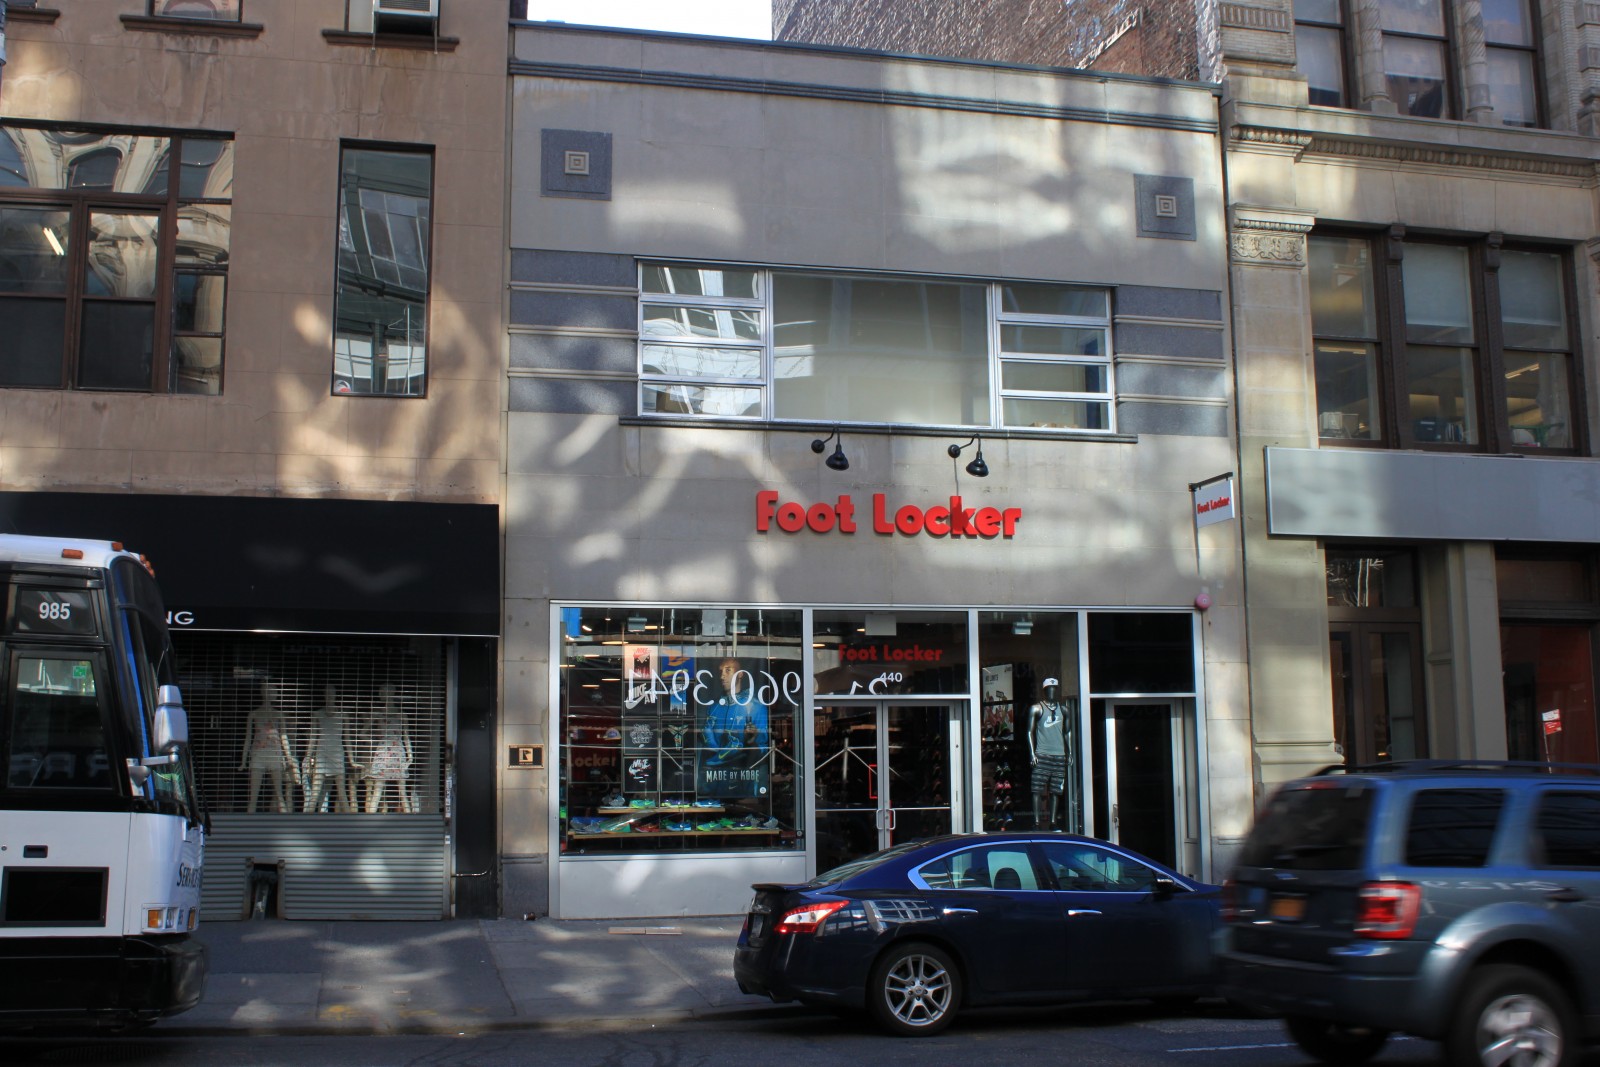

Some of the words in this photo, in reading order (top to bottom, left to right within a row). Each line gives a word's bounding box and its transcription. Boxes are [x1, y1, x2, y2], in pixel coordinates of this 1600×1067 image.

[1197, 502, 1210, 514] Foot
[1210, 496, 1230, 510] Locker
[755, 490, 857, 534] Foot
[872, 492, 1022, 538] Locker
[39, 602, 71, 620] 985
[838, 644, 878, 661] Foot
[883, 644, 943, 661] Locker
[879, 672, 903, 683] 440
[570, 753, 616, 768] ocker
[706, 770, 727, 783] MADE
[729, 771, 738, 780] BY
[740, 769, 760, 782] KOBE
